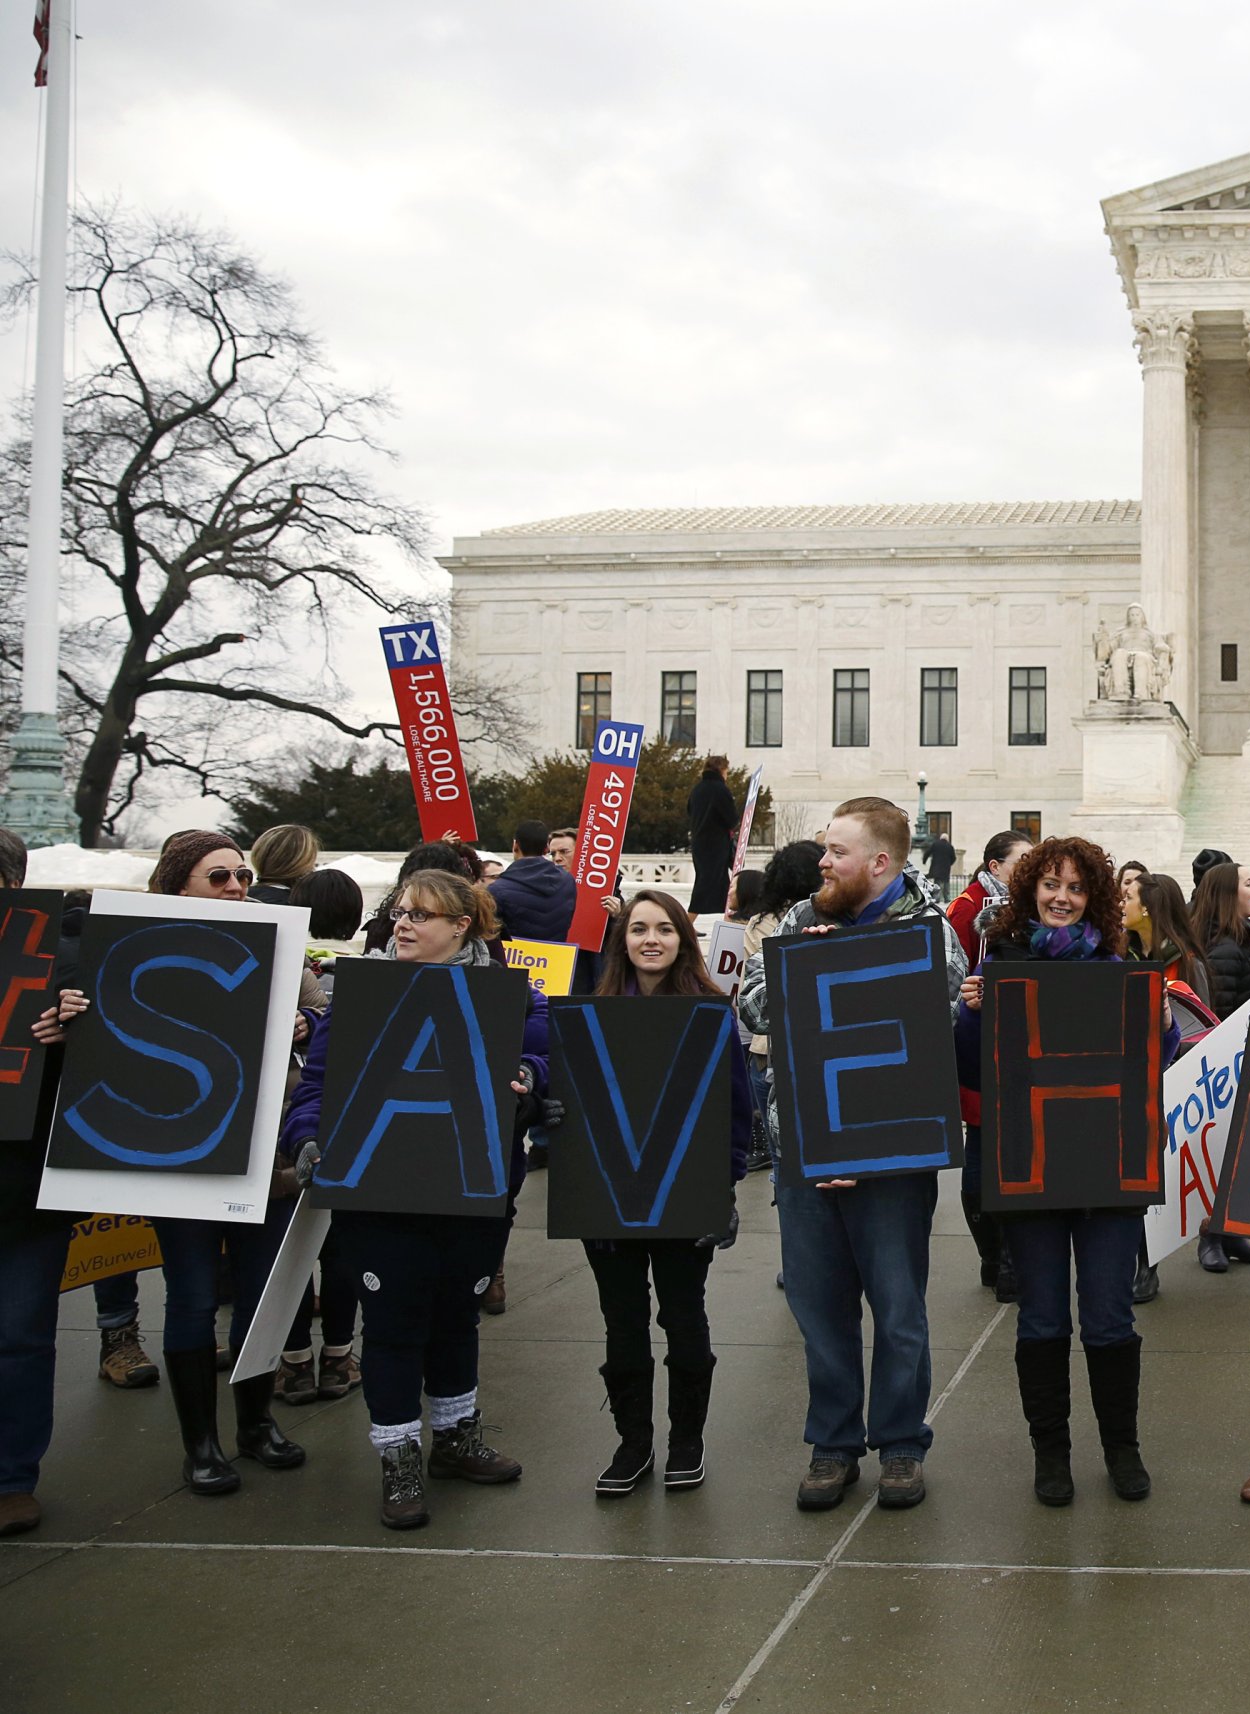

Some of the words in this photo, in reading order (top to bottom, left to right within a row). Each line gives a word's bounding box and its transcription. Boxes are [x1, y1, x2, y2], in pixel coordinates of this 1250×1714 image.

[384, 628, 437, 662] TX
[408, 670, 460, 802] 1,566,000
[409, 725, 421, 747] LOSE
[598, 728, 639, 759] OH
[414, 747, 433, 803] HEALTHCARE
[586, 804, 597, 827] LOSE
[586, 771, 625, 889] 497,000
[576, 828, 592, 885] HEALTHCARE
[503, 947, 548, 968] llion
